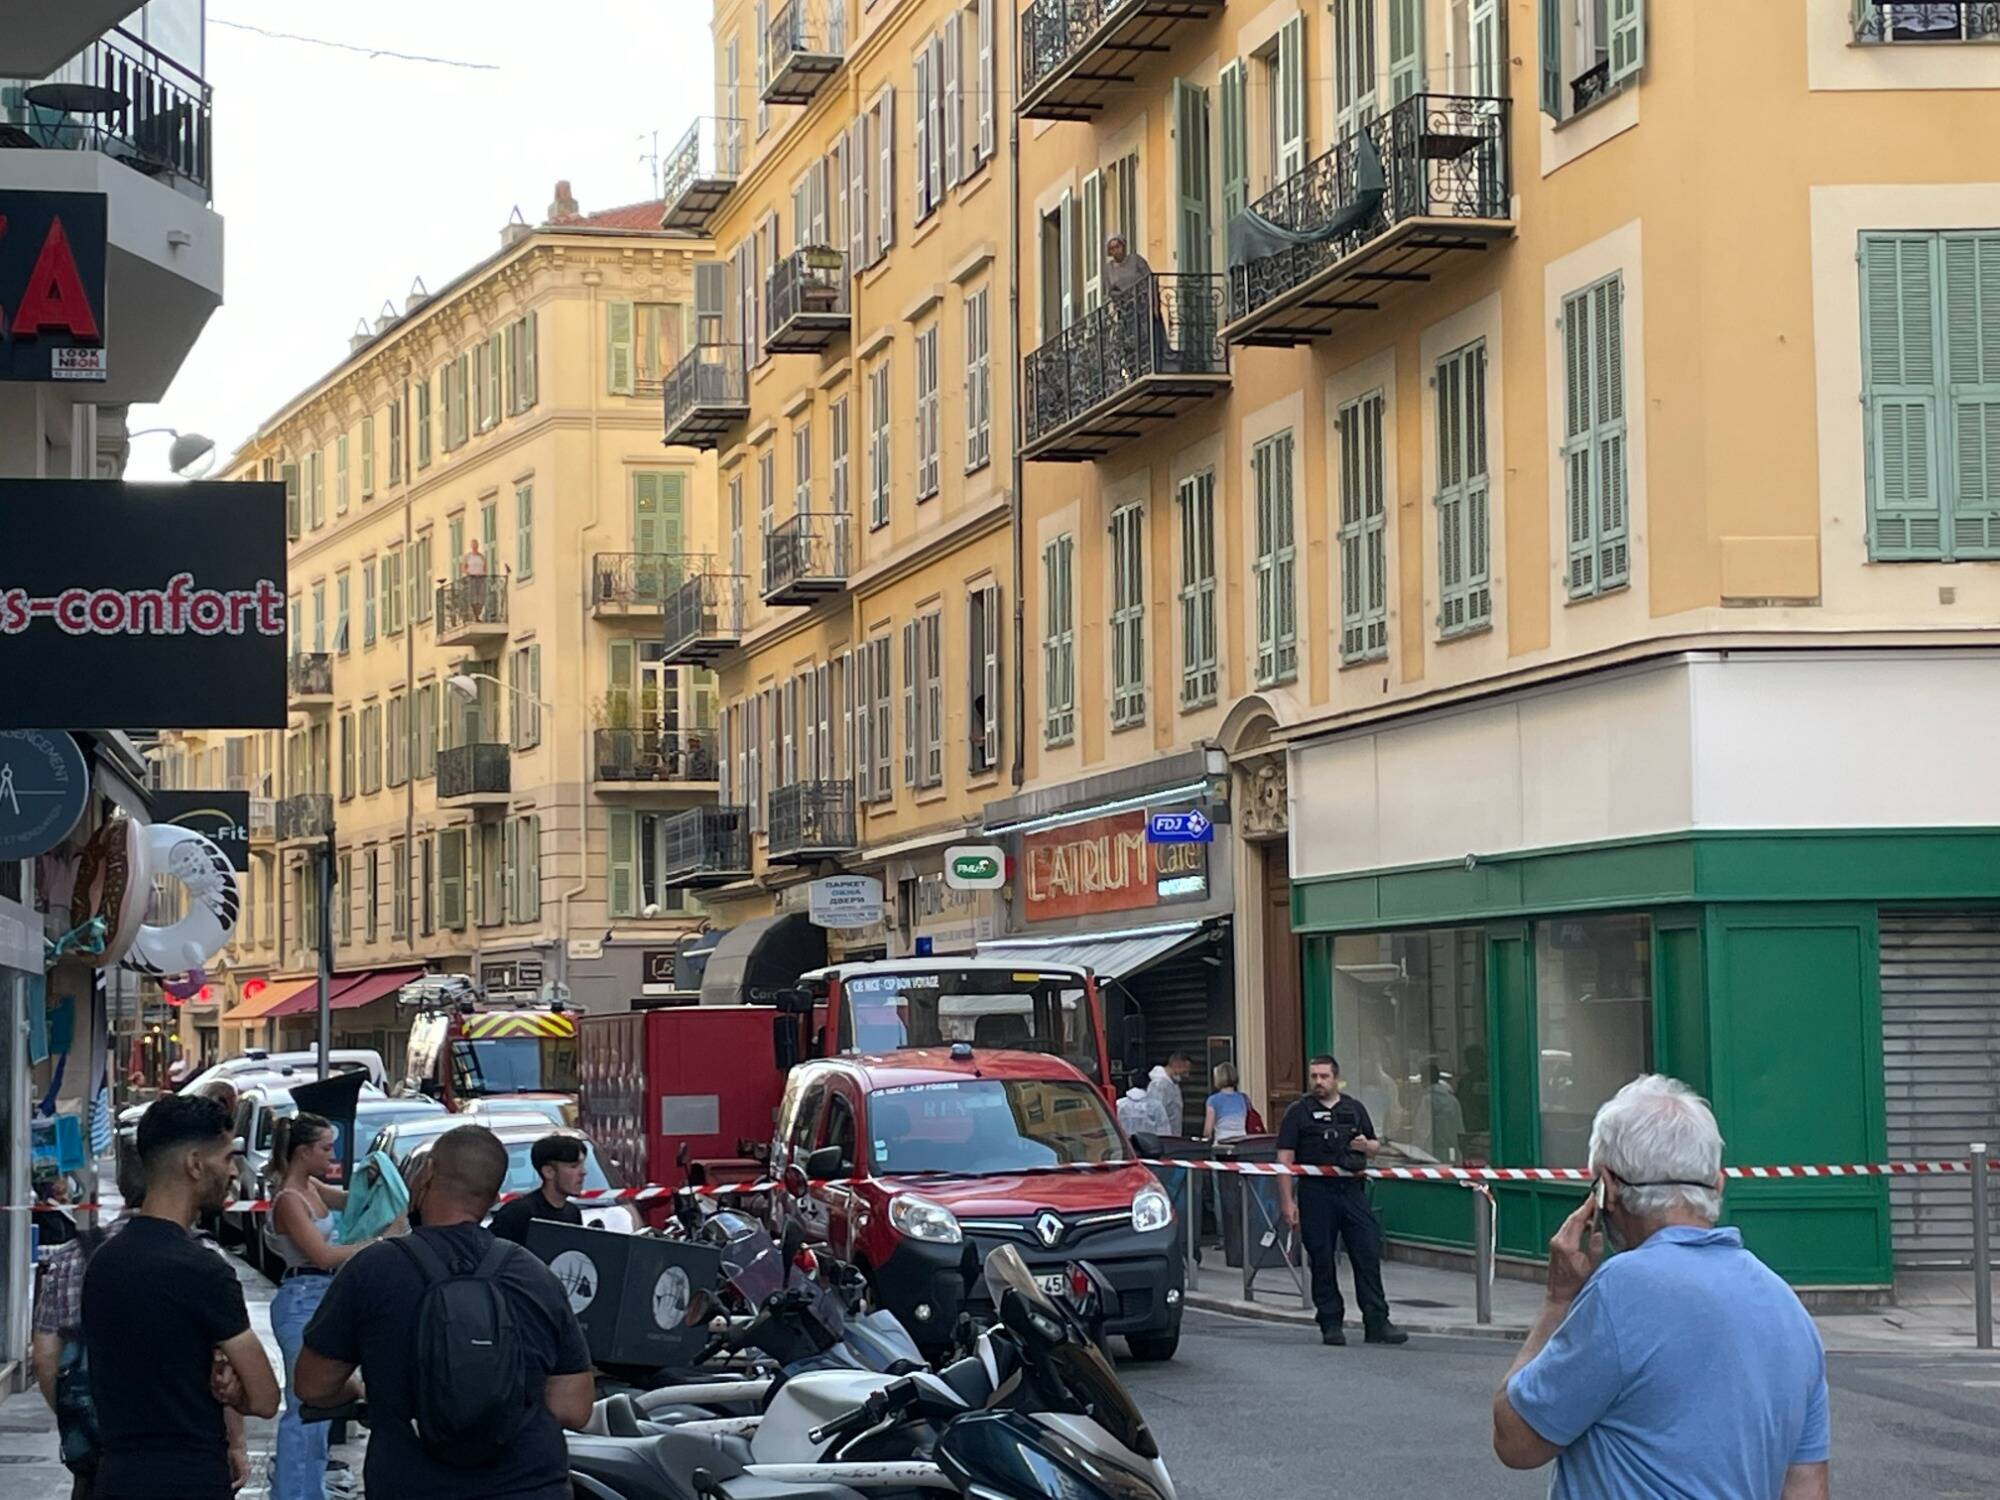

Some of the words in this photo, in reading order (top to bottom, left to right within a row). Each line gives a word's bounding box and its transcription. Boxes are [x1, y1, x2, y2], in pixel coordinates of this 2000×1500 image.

[0, 212, 99, 337] A
[59, 350, 98, 358] LOOK
[59, 359, 99, 367] NEON
[0, 573, 285, 635] s-confort
[1156, 818, 1183, 831] FDJ
[1026, 829, 1149, 902] L'ATRIUM
[865, 979, 881, 991] NICE
